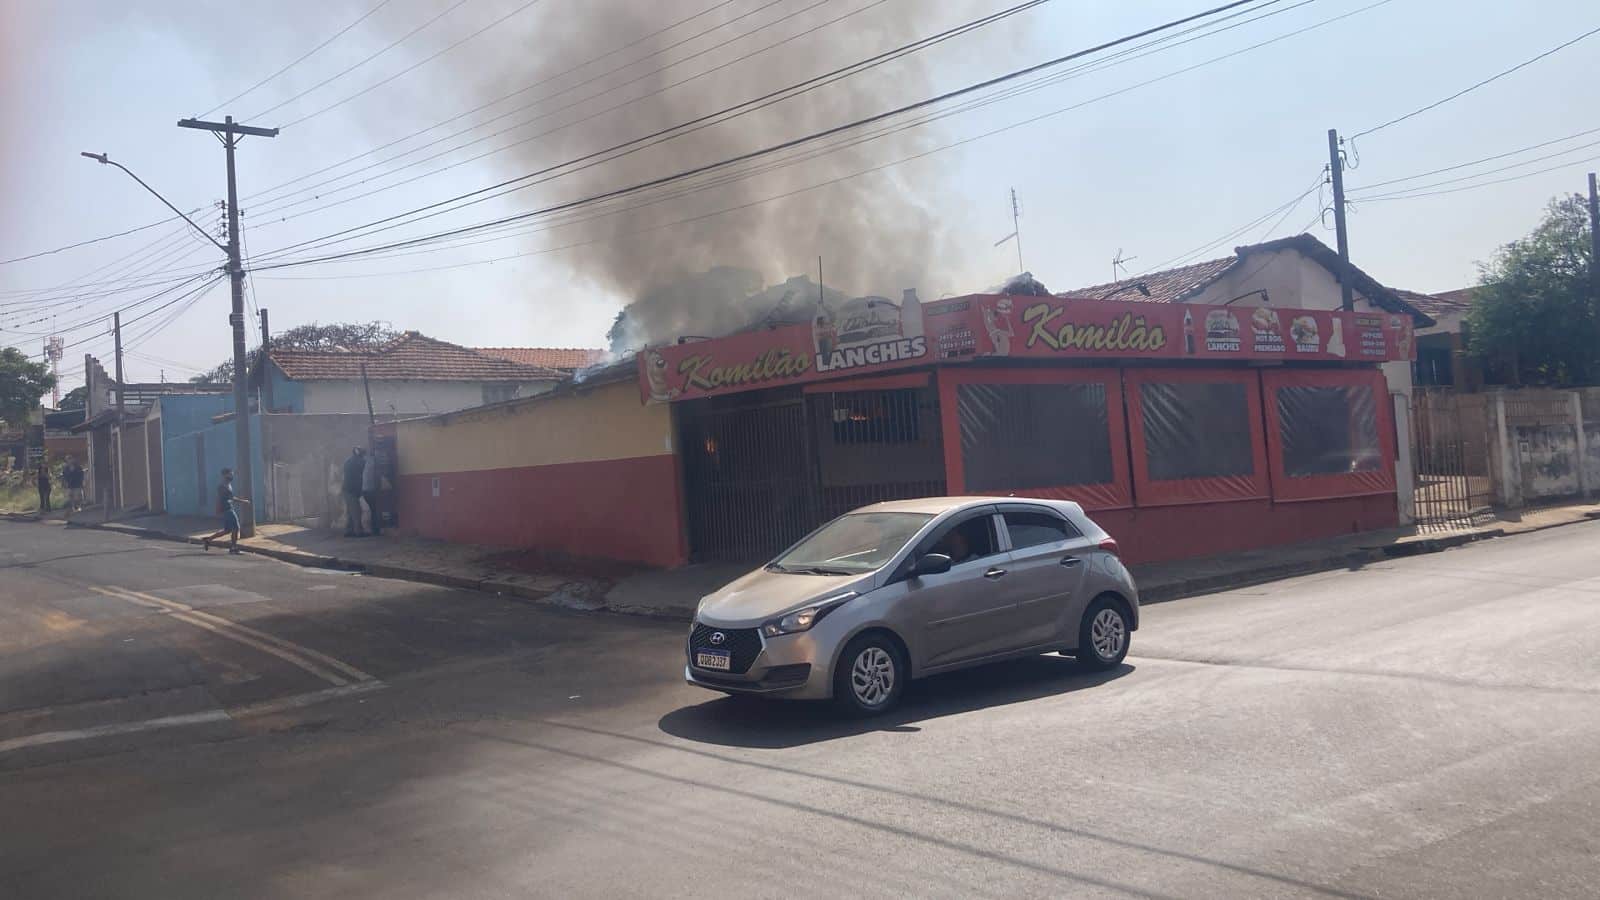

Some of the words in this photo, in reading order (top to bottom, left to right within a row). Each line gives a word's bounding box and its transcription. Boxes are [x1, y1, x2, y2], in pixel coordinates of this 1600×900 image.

[1023, 303, 1166, 350] Komilão
[815, 336, 928, 373] LANCHES
[1206, 341, 1240, 352] LANCHES
[1296, 344, 1319, 353] BAURU
[678, 348, 812, 392] Komilão
